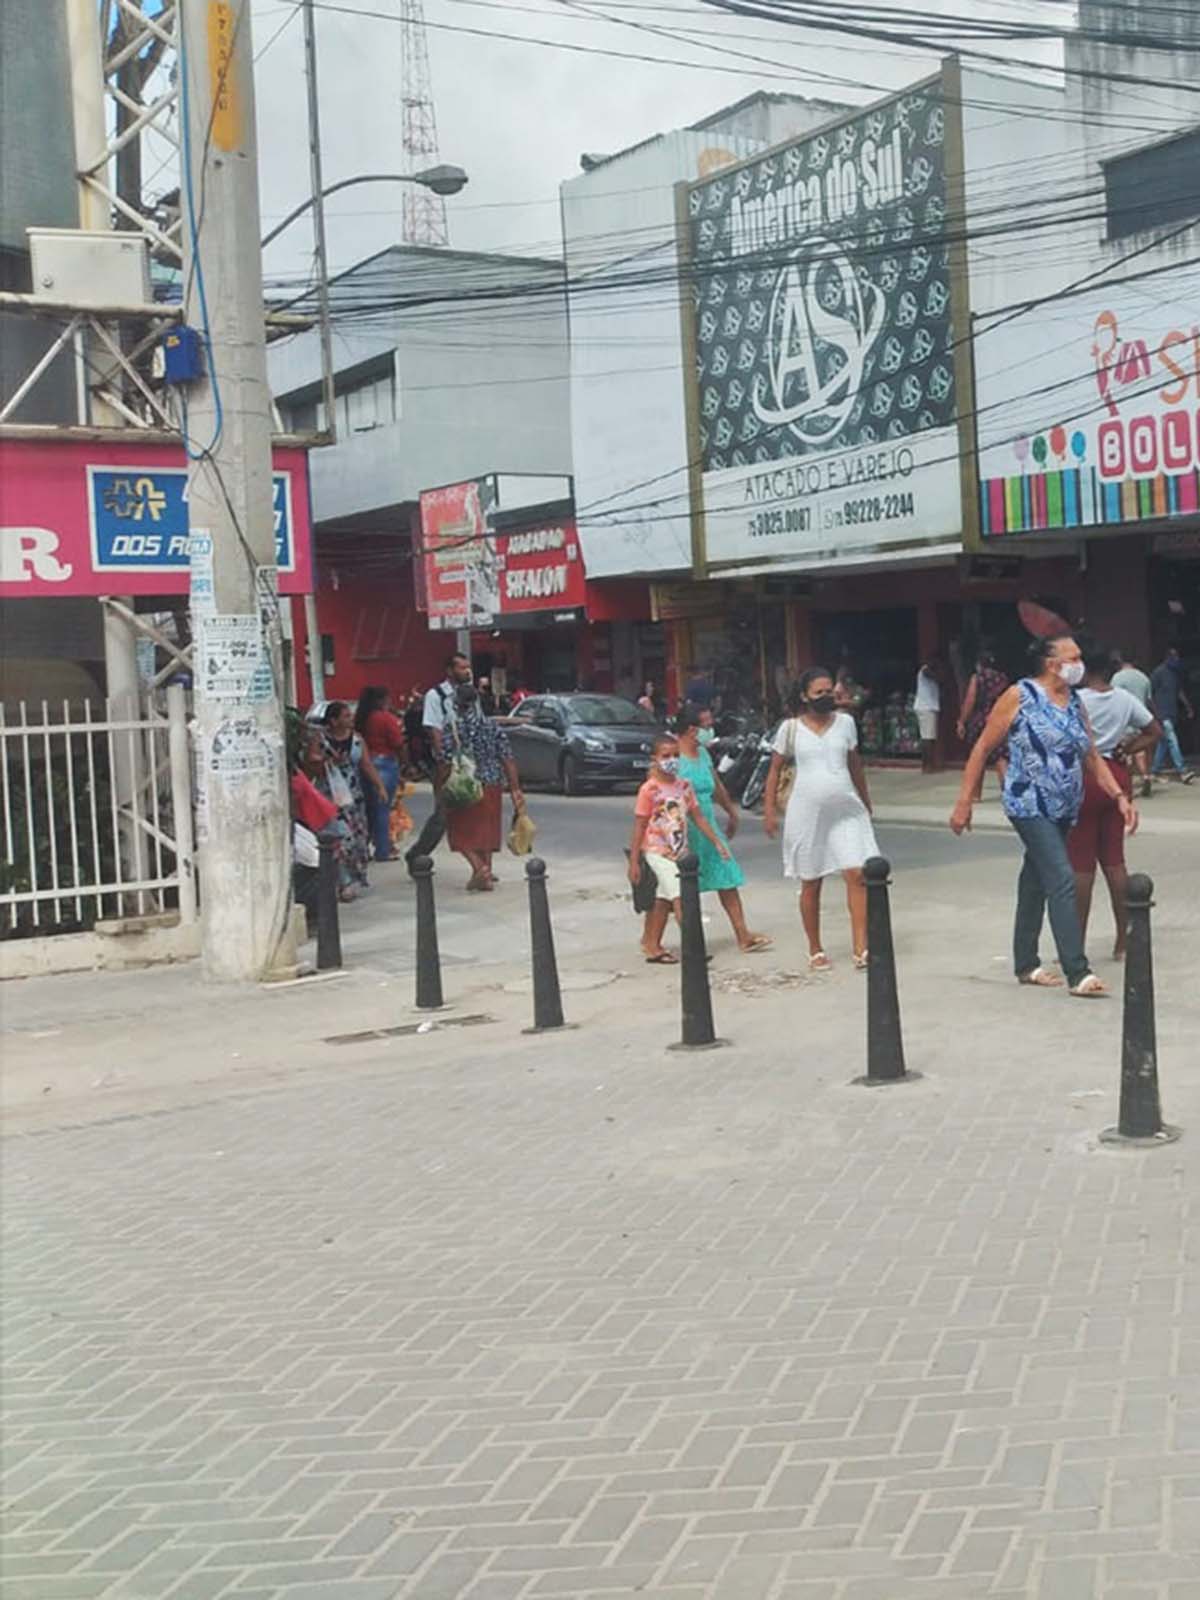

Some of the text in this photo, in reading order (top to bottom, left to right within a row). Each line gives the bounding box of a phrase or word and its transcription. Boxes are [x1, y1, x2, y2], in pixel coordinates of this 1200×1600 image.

[826, 155, 857, 223] do
[861, 127, 903, 210] Sul
[744, 464, 821, 501] ATACADO
[841, 448, 914, 484] VAREJO
